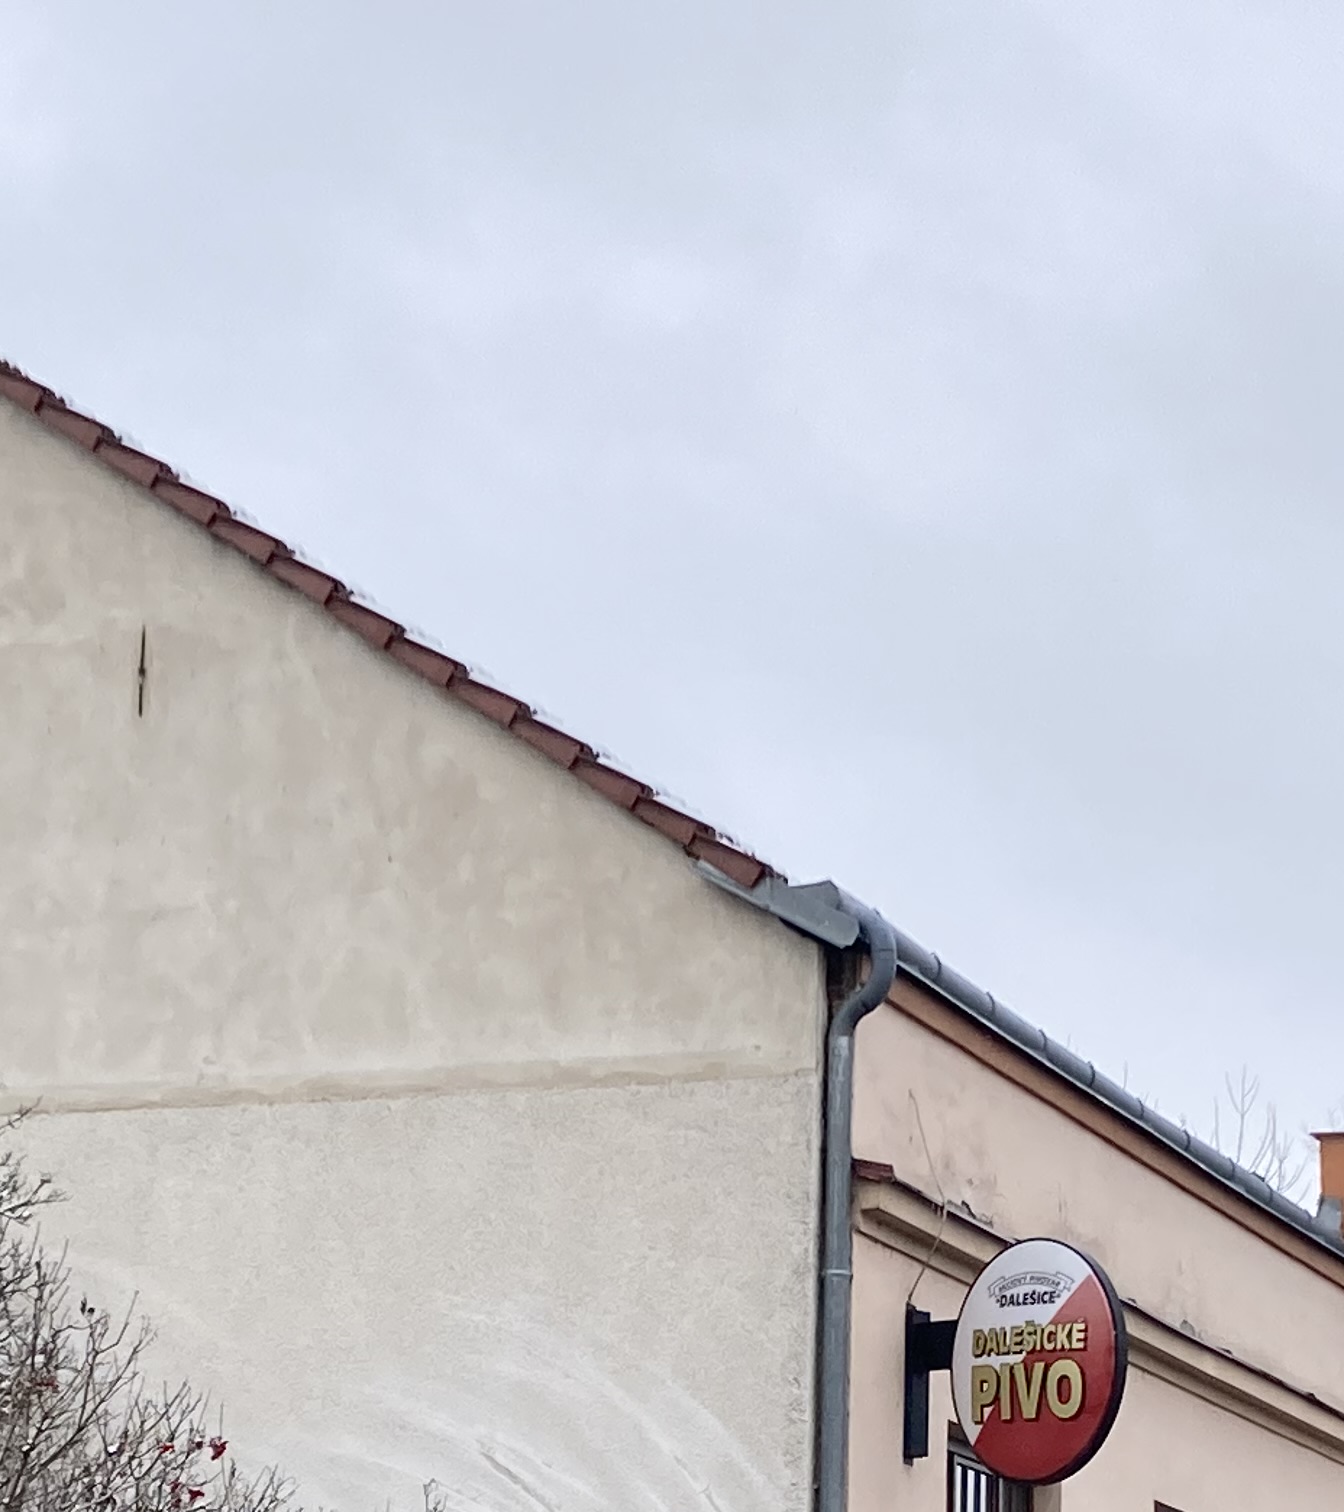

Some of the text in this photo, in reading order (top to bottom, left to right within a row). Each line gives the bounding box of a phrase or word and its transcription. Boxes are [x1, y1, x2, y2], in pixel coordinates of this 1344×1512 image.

[999, 1290, 1057, 1308] DALEŠICE
[972, 1320, 1087, 1358] DALEŠICKÉ
[971, 1358, 1085, 1424] PIVO
